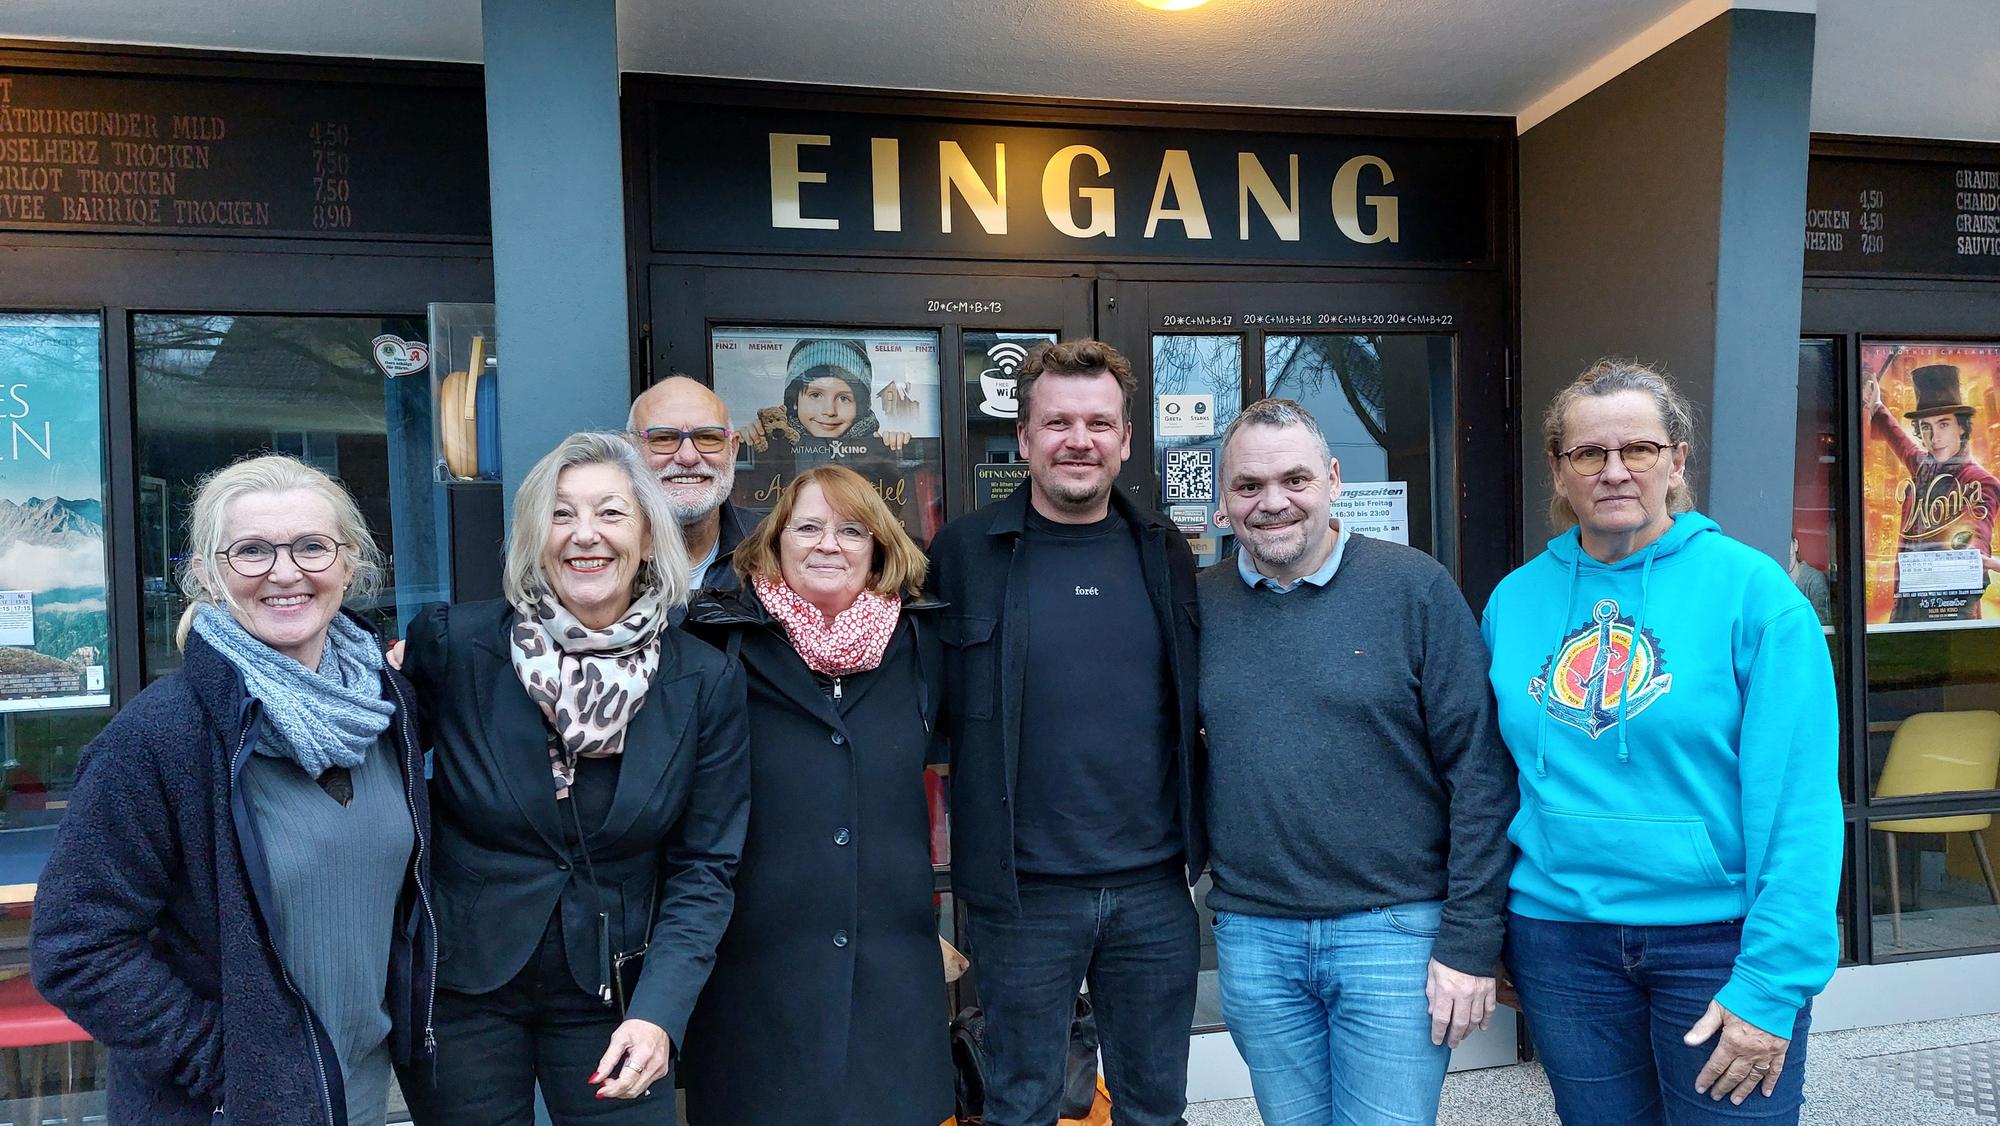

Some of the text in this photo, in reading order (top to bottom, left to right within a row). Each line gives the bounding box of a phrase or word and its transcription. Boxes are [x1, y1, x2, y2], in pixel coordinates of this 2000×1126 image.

[173, 114, 226, 141] MILD
[309, 121, 349, 147] 4,50
[112, 141, 209, 170] TROCKEN
[312, 150, 349, 177] 7,50
[77, 169, 177, 195] TROCKEN
[313, 177, 349, 203] 7,50
[769, 132, 1400, 244] EINGANG
[1860, 190, 1884, 211] 4,50
[0, 194, 351, 230] VEE BARRIQE TROCKEN 8,90
[1806, 208, 1884, 233] OCKEN 4,50
[1861, 234, 1884, 255] 7,80
[715, 342, 737, 350] FINZI
[748, 343, 783, 351] MEHMET
[875, 344, 902, 352] SELLEM
[915, 345, 936, 353] FINZI
[790, 445, 868, 454] MITMACH KINO
[1367, 500, 1393, 508] Freitag
[1369, 509, 1390, 517] 23:00
[1895, 473, 1988, 534] Wonka
[1350, 525, 1381, 533] Sonntag
